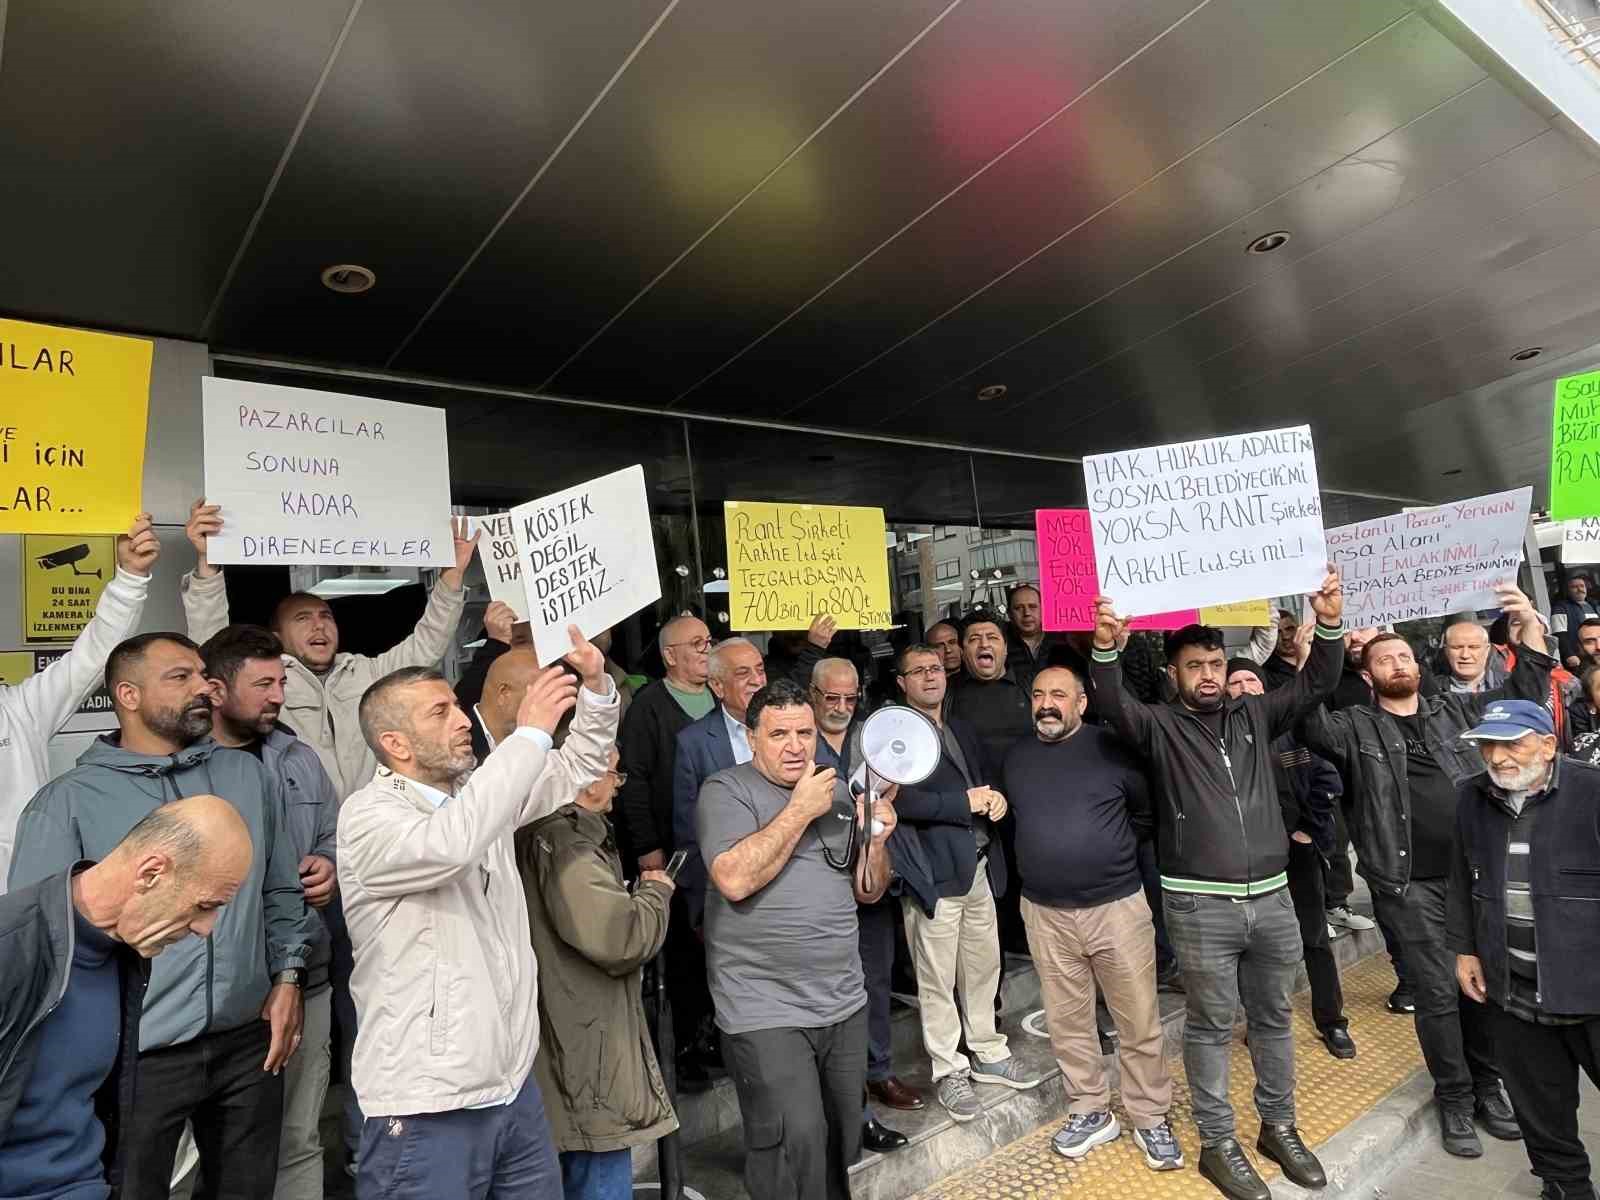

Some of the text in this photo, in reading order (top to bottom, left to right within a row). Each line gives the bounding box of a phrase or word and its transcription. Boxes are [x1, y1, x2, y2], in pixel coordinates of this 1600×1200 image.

[239, 404, 385, 440] PAZARCILAR
[35, 442, 84, 467] İÇİN
[246, 451, 339, 476] SONUNA
[281, 491, 358, 518] KADAR
[1092, 480, 1178, 512] SOSYAL
[524, 494, 594, 545] KÖSTEK
[734, 507, 784, 542] Rant
[1098, 507, 1190, 545] YOKSA
[1193, 494, 1269, 531] RANT
[243, 536, 432, 558] DİRENECEKLER
[530, 531, 588, 574] DEĞİL
[535, 547, 602, 599] DESTEK
[738, 566, 866, 588] TEZGAH BAŞINA
[52, 599, 89, 607] 24 SAAT
[68, 586, 90, 594] BİNA
[42, 611, 83, 619] KAMERA
